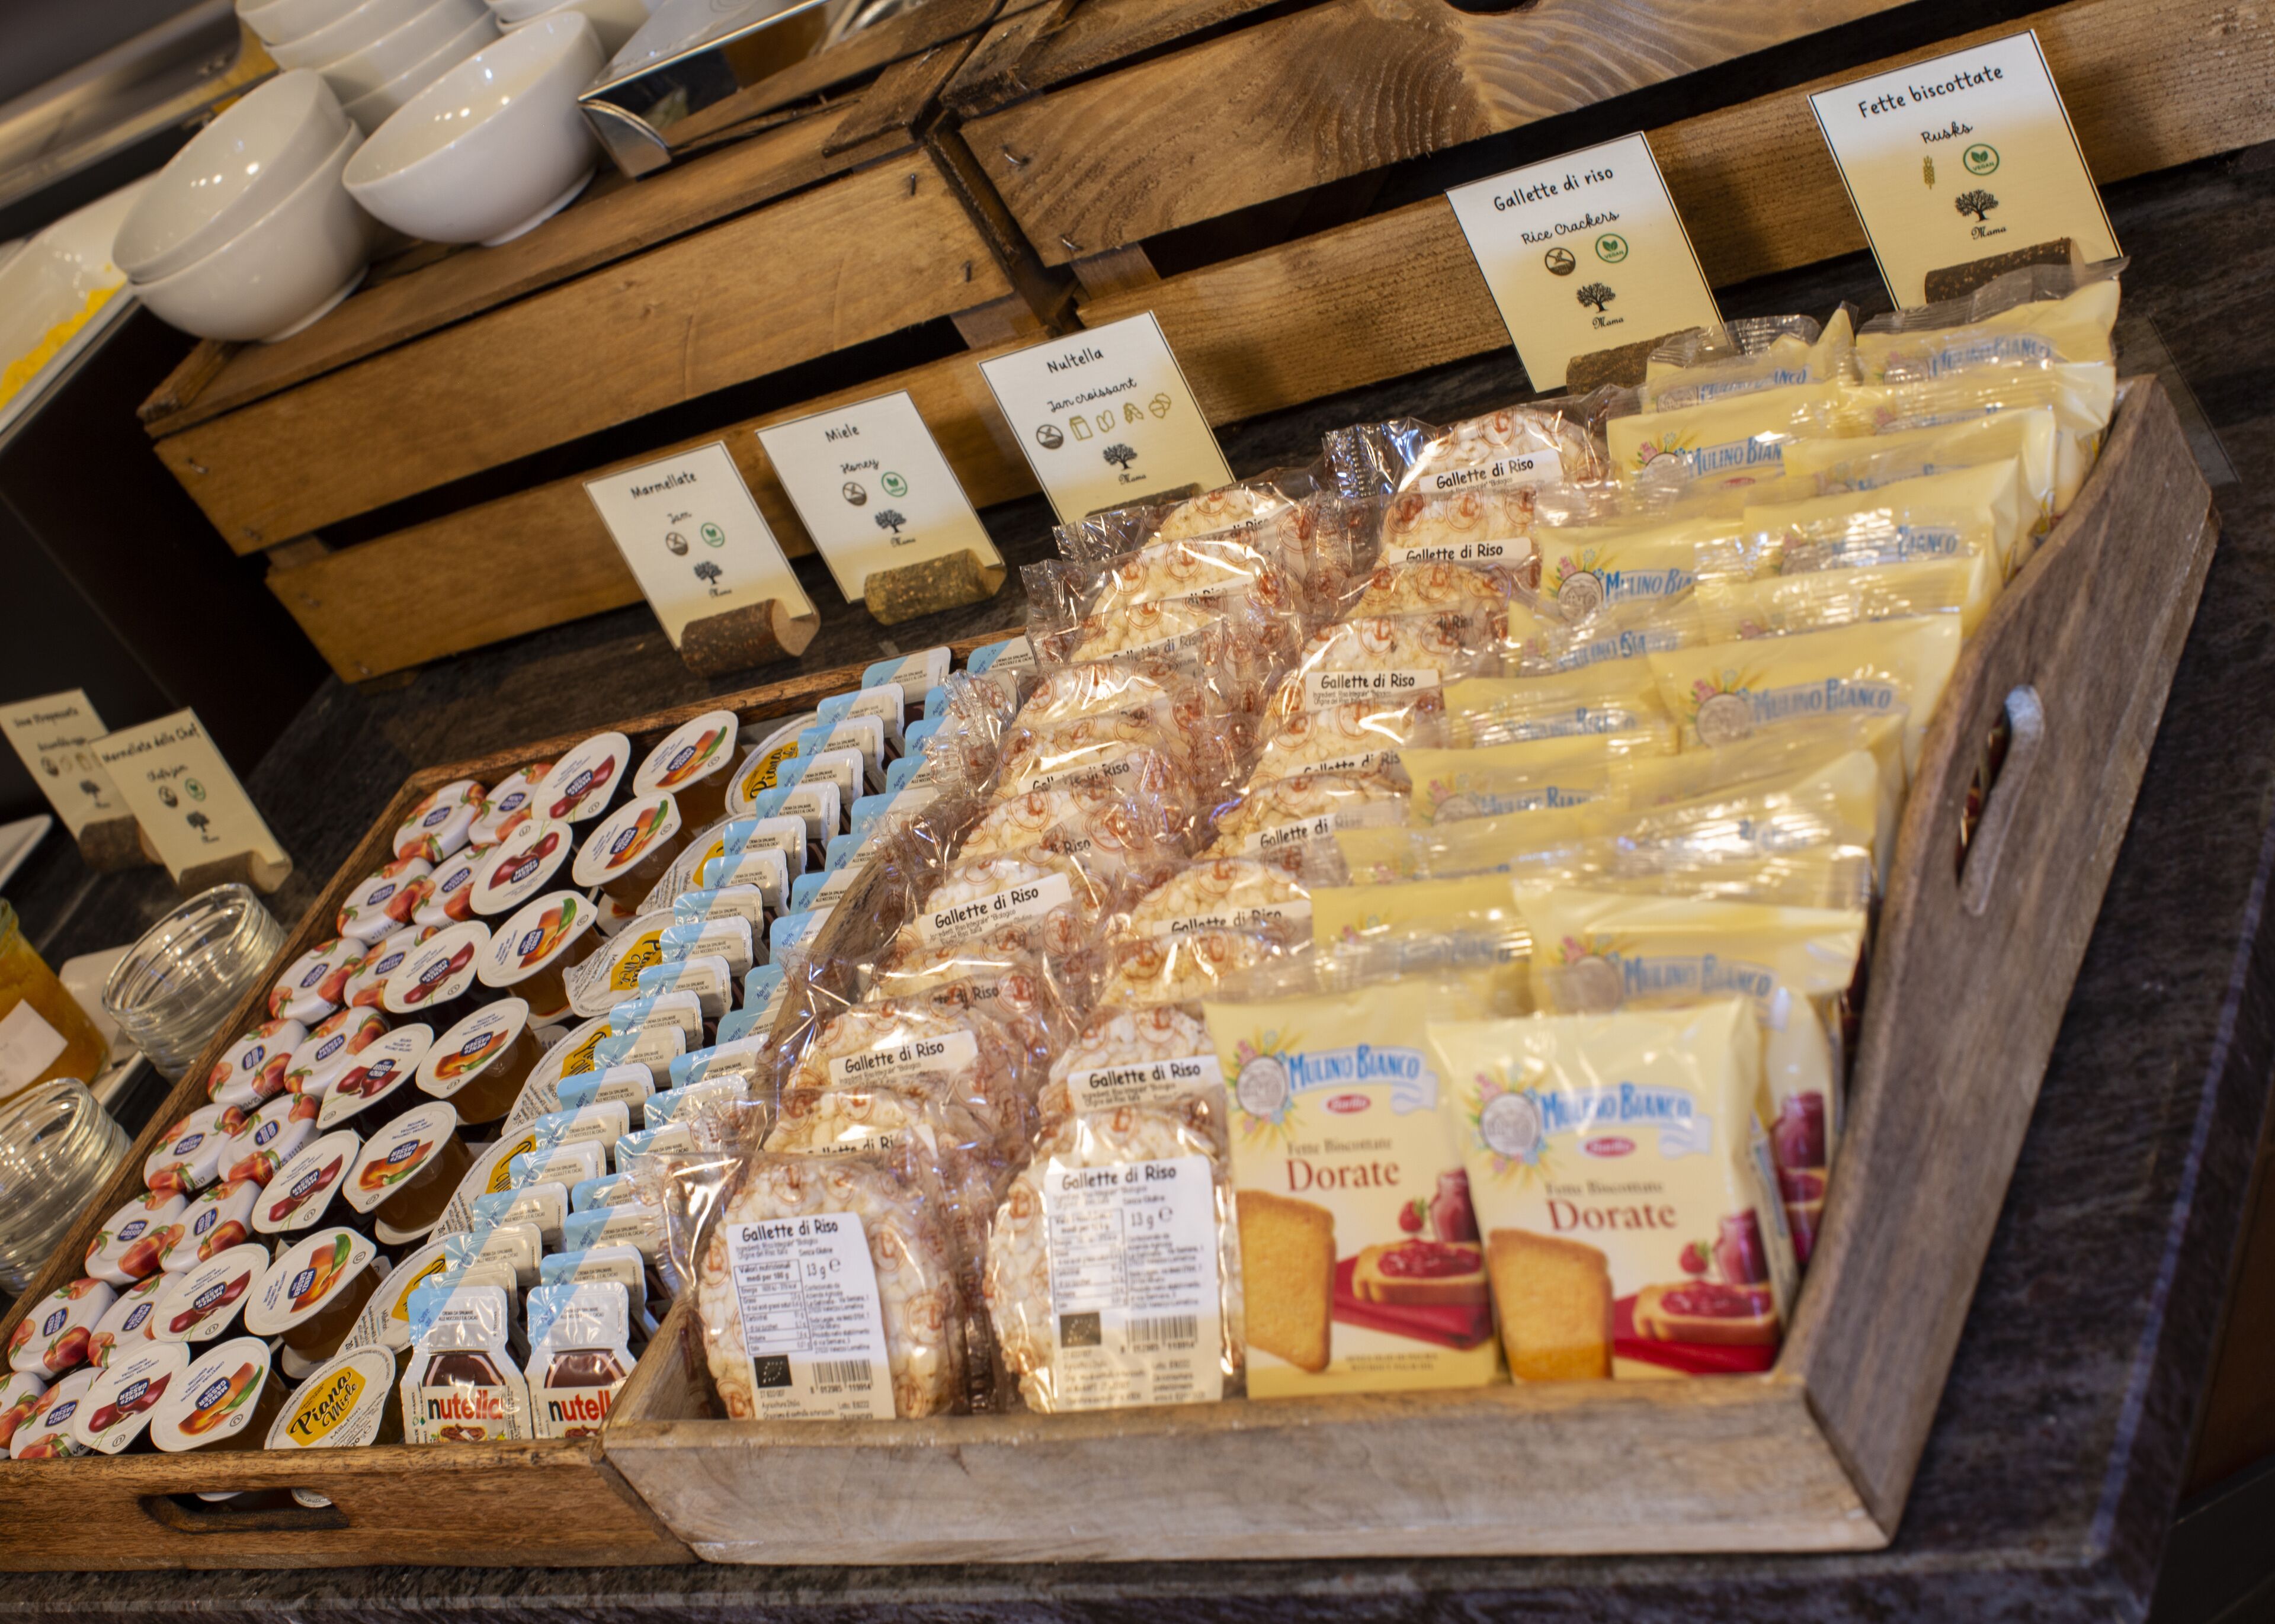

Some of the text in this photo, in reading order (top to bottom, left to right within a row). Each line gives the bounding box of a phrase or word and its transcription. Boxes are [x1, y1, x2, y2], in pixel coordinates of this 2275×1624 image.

[1858, 65, 2003, 118] Fette biscottate
[1921, 121, 1973, 144] Rusks
[1973, 161, 1994, 171] VEGAN
[1494, 168, 1613, 211] Gallette di riso
[1521, 211, 1619, 245] Rice Crackers
[1971, 226, 2007, 240] Mama
[1604, 250, 1623, 259] VEGAN
[1592, 316, 1624, 329] Mama
[1076, 377, 1137, 404] croissant
[825, 423, 860, 442] Miele
[840, 459, 879, 474] Honey
[1690, 436, 1782, 477] MULINO BIAN
[630, 471, 697, 499] Marmellate
[1437, 458, 1533, 490] Gallette di Riso
[1460, 545, 1471, 559] di
[1478, 544, 1503, 557] Riso
[1665, 568, 1695, 594] BIA
[1321, 673, 1415, 689] Gallette di Riso
[1825, 678, 1893, 710] BIANCO
[1103, 762, 1129, 777] Riso
[1381, 750, 1400, 766] Ris
[1063, 839, 1091, 854] Riso
[1261, 827, 1308, 848] Gallette
[1315, 819, 1328, 834] di
[835, 852, 847, 868] Aprire
[798, 891, 809, 907] Aprire
[935, 888, 1039, 929] Gallette di Riso
[1233, 911, 1245, 927] di
[1623, 952, 1772, 996] MULINO BIANCO
[757, 983, 770, 999] Aprire
[973, 986, 999, 1001] Riso
[845, 1054, 893, 1073] Gallette
[899, 1047, 912, 1062] di
[916, 1042, 944, 1058] Riso
[1289, 1044, 1421, 1090] MULINO BIANCO
[1089, 1062, 1201, 1089] Gallette di Riso
[863, 1138, 874, 1151] di
[880, 1134, 893, 1149] Ri
[1062, 1164, 1177, 1191] Gallette di Riso
[1286, 1157, 1400, 1193] Dorate
[1131, 1212, 1155, 1231] 13 g
[1546, 1199, 1678, 1232] Dorate
[742, 1219, 838, 1242] Gallette di Riso
[807, 1263, 826, 1279] 13 g
[119, 1381, 148, 1401] GASSER
[197, 1380, 226, 1407] GASSER
[290, 1371, 351, 1436] Piana
[322, 1383, 358, 1427] Miele
[428, 1389, 504, 1420] nutella
[549, 1389, 611, 1422] nutell
[331, 1407, 360, 1439] Millefiori
